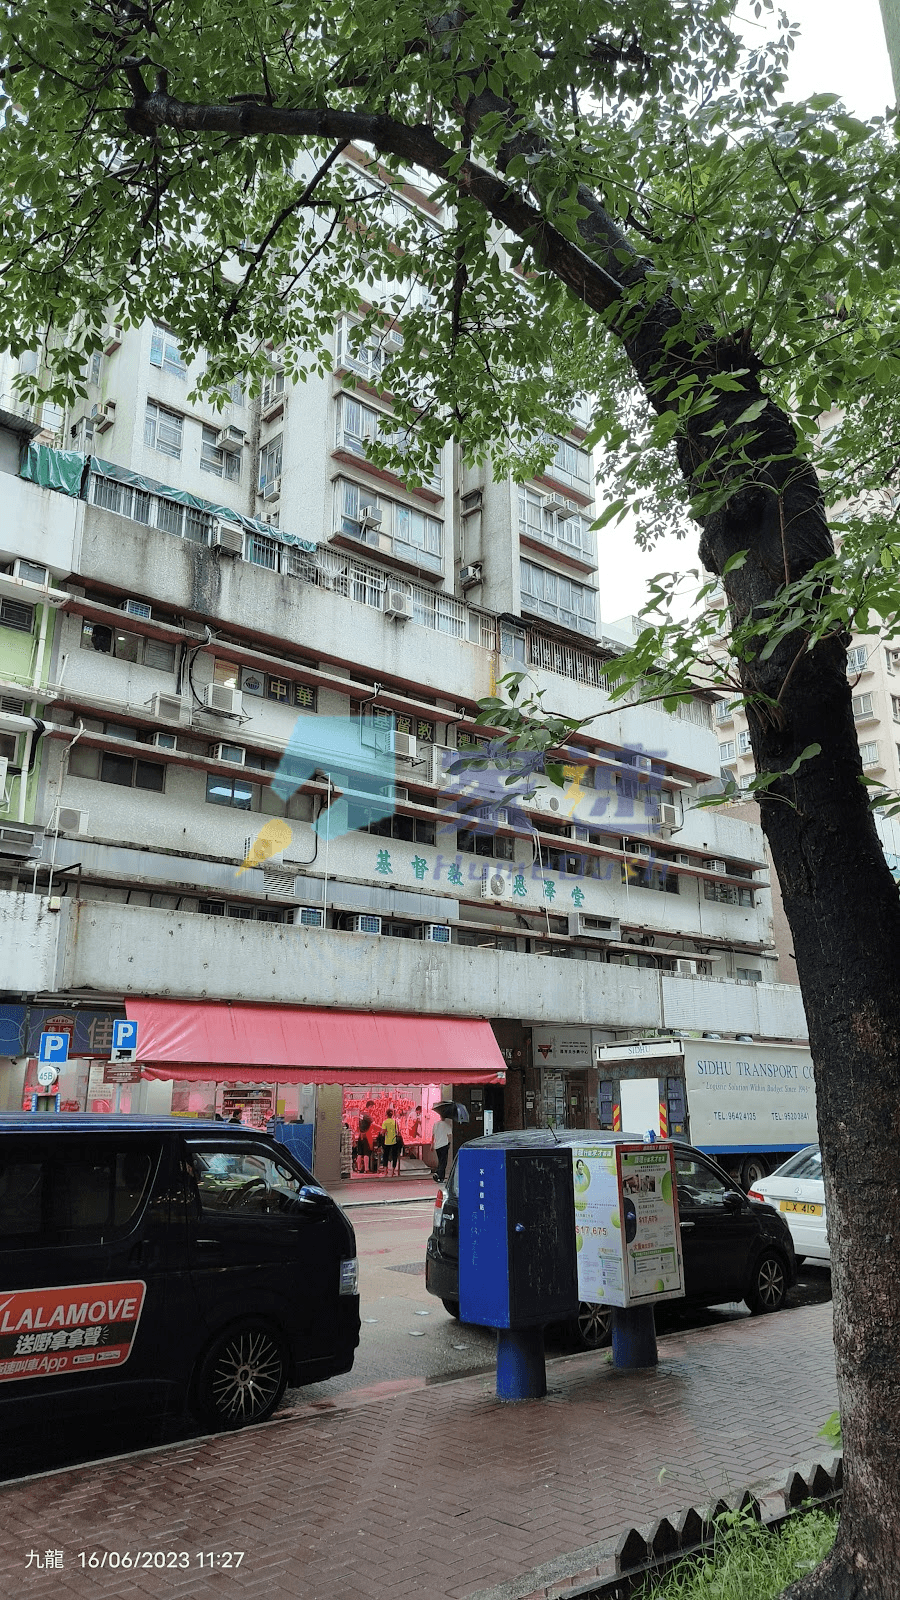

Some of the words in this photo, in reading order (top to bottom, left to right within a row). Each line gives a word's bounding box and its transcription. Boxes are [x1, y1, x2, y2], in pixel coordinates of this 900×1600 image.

[271, 680, 314, 706] 中華
[374, 709, 434, 743] 基督教
[116, 1023, 134, 1046] P
[44, 1035, 64, 1060] P
[628, 1045, 651, 1055] SIDHU
[39, 1072, 53, 1081] 45B
[697, 1060, 732, 1076] SIDHU
[736, 1062, 798, 1079] TRANSPORT
[786, 1202, 797, 1212] LX
[801, 1204, 816, 1213] 419
[575, 1225, 607, 1236] $17,675
[0, 1298, 137, 1332] LALAMOVE
[13, 1326, 102, 1356] 送嘢拿拿聲
